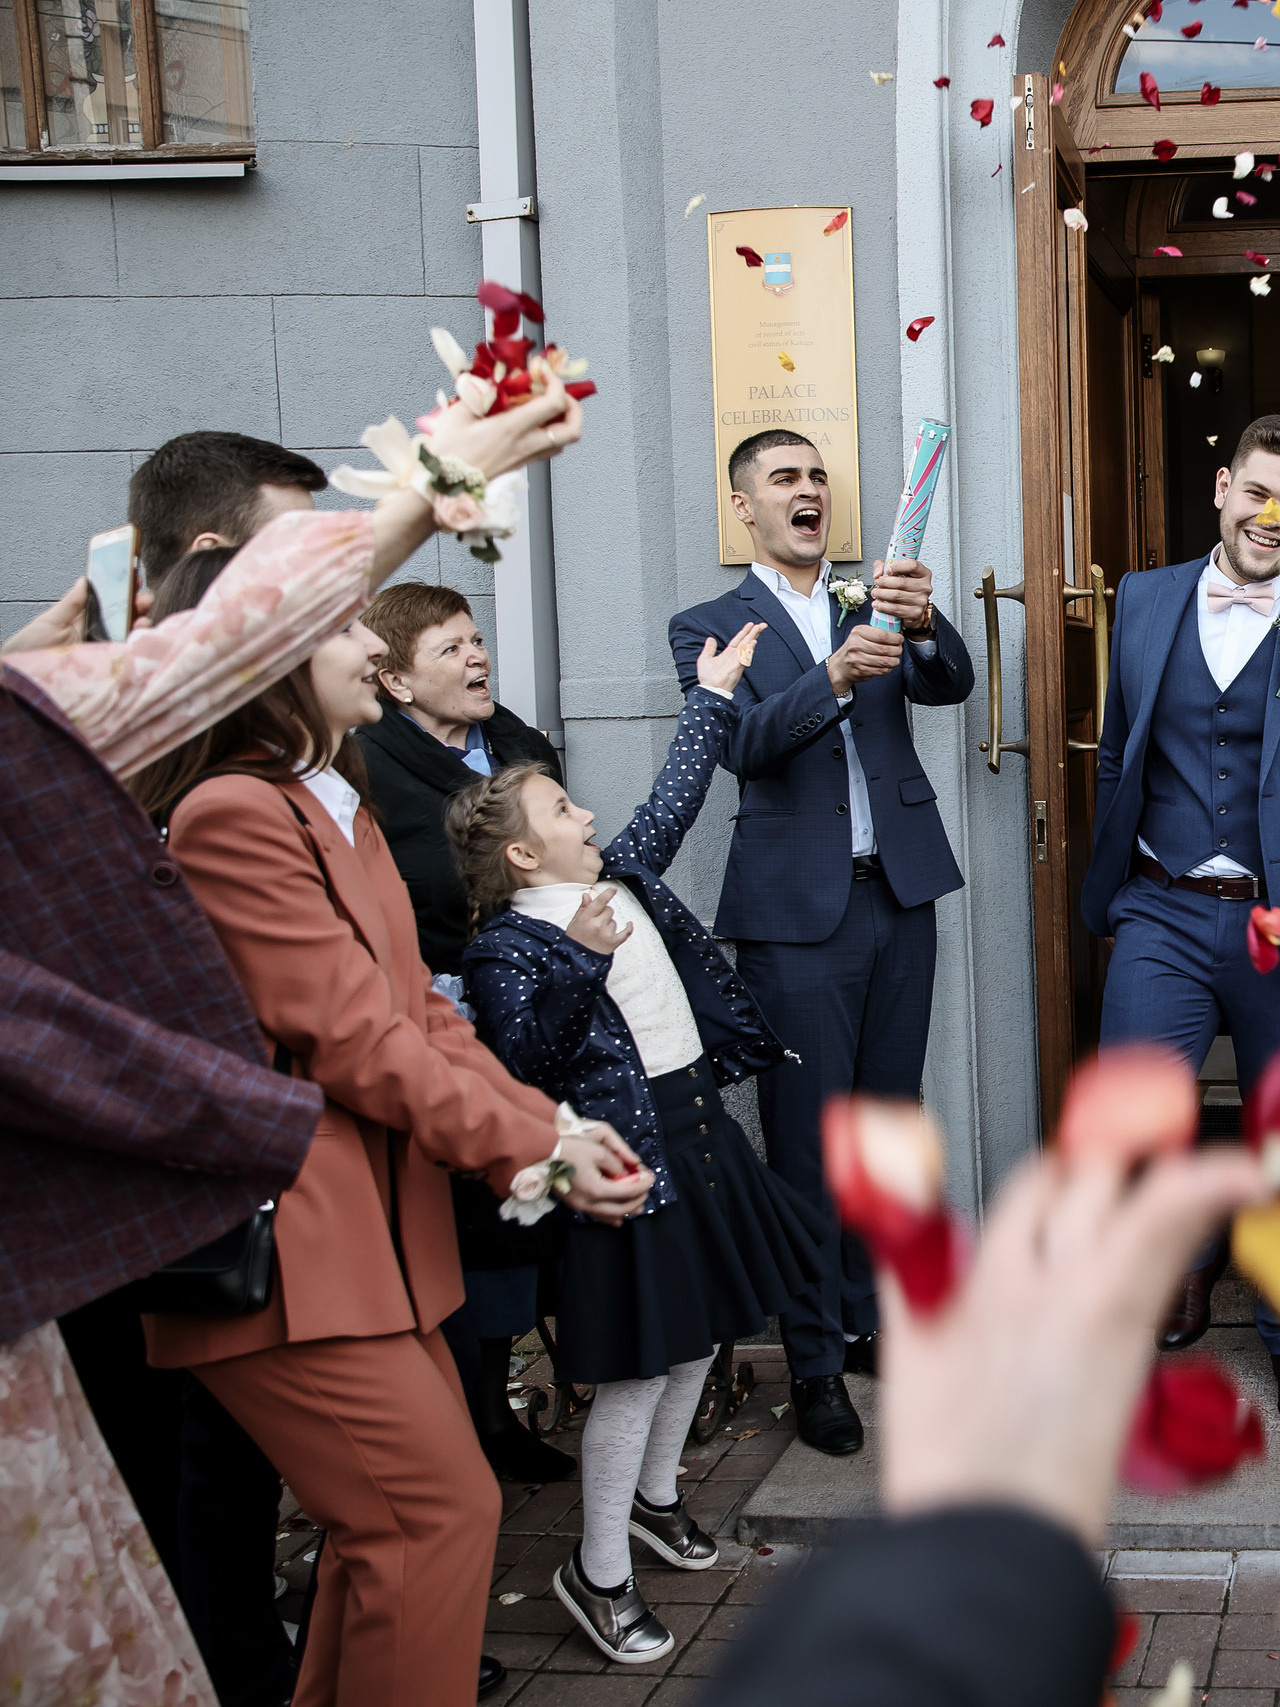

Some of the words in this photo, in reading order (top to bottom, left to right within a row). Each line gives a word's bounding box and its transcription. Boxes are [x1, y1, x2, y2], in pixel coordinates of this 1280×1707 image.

[759, 320, 801, 329] Management
[763, 330, 784, 338] record
[748, 341, 762, 349] civil
[762, 340, 781, 348] status
[790, 339, 814, 348] Kaluga
[748, 384, 817, 400] PALACE
[721, 407, 850, 425] CELEBRATIONS
